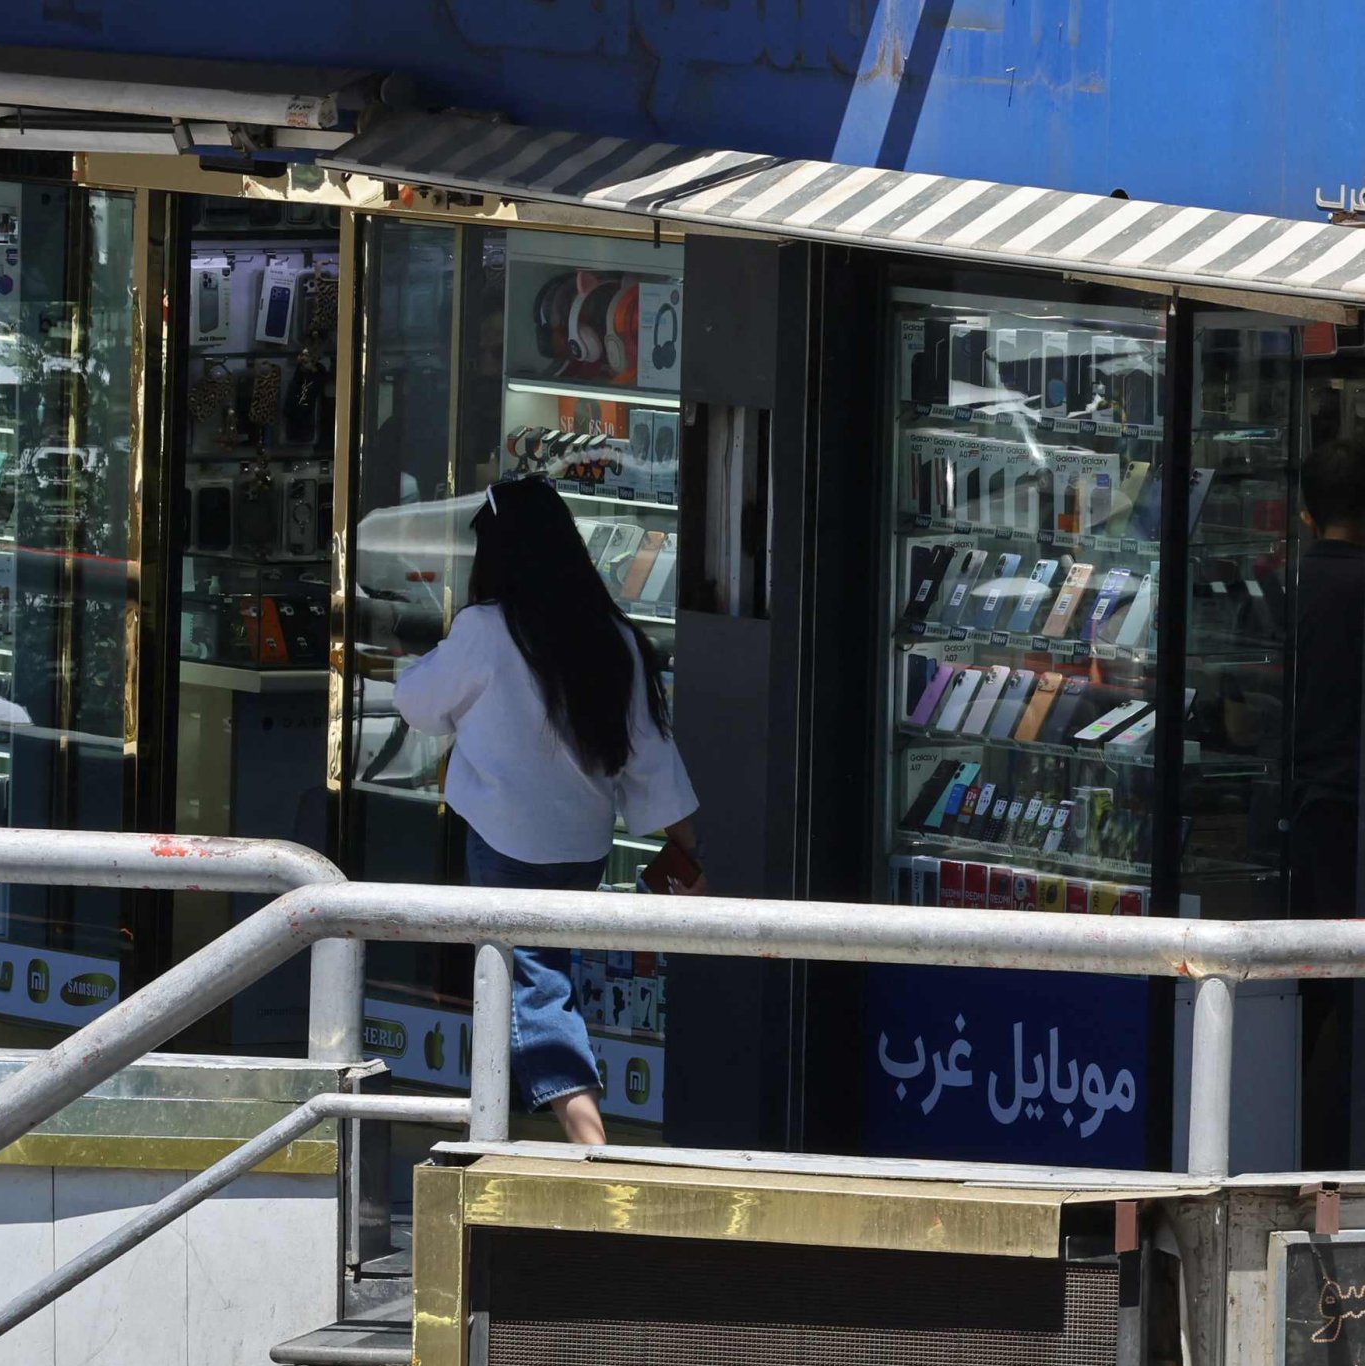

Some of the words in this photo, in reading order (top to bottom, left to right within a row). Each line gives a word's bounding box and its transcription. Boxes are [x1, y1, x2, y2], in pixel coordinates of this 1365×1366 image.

[918, 404, 930, 415] New
[956, 409, 970, 420] New
[997, 413, 1013, 425] New
[1038, 418, 1054, 430] New
[1080, 421, 1096, 434] New
[1123, 426, 1139, 439] New
[933, 437, 957, 448] Galaxy
[933, 447, 946, 456] A07
[980, 453, 993, 462] A07
[1080, 457, 1108, 468] Galaxy
[915, 516, 930, 527] New
[955, 522, 971, 533] New
[996, 527, 1012, 538] New
[1038, 532, 1053, 544] New
[1081, 537, 1095, 548] New
[1121, 541, 1137, 552] New
[910, 622, 925, 633] New
[950, 628, 967, 639] New
[991, 632, 1008, 645] New
[1033, 637, 1049, 649] New
[1074, 641, 1090, 654] New
[944, 644, 973, 655] Galaxy
[944, 654, 958, 663] A07
[910, 753, 938, 764] Galaxy
[940, 888, 962, 898] REDMI
[964, 891, 986, 900] REDMI
[989, 894, 1012, 904] REDMI
[67, 978, 109, 999] SAMSUNG
[363, 1025, 405, 1051] HERLO
[877, 1013, 973, 1115] غرب
[988, 1022, 1136, 1138] موبایل
